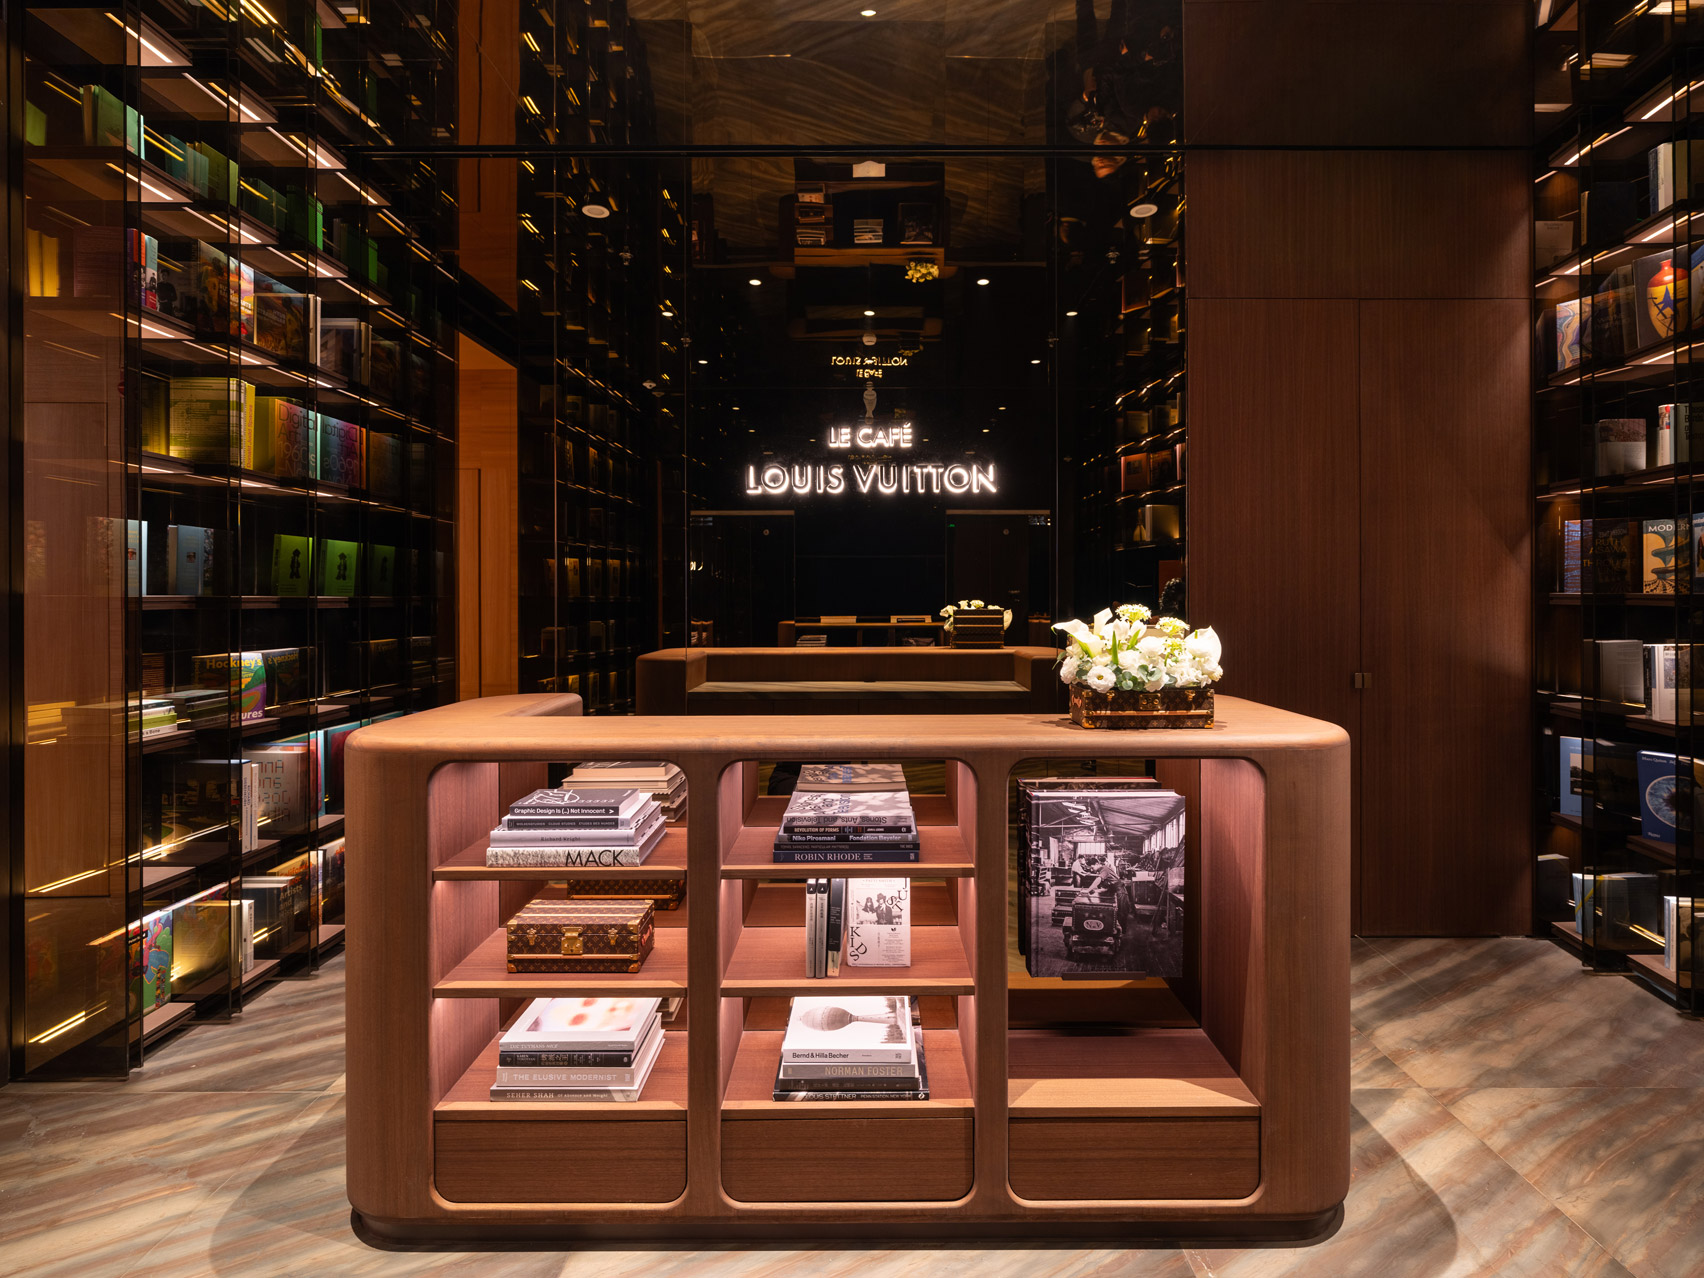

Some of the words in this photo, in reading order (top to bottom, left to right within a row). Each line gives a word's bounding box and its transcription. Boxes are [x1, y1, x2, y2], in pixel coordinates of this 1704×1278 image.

[829, 427, 850, 447] LE
[857, 421, 913, 447] CAFÉ
[746, 463, 845, 494] LOUIS
[852, 463, 998, 494] VUITTON
[565, 850, 624, 867] MACK
[795, 853, 825, 861] ROBIN
[827, 853, 861, 861] RHODE
[825, 1067, 864, 1075] NORMAN
[868, 1067, 903, 1075] FOSTER
